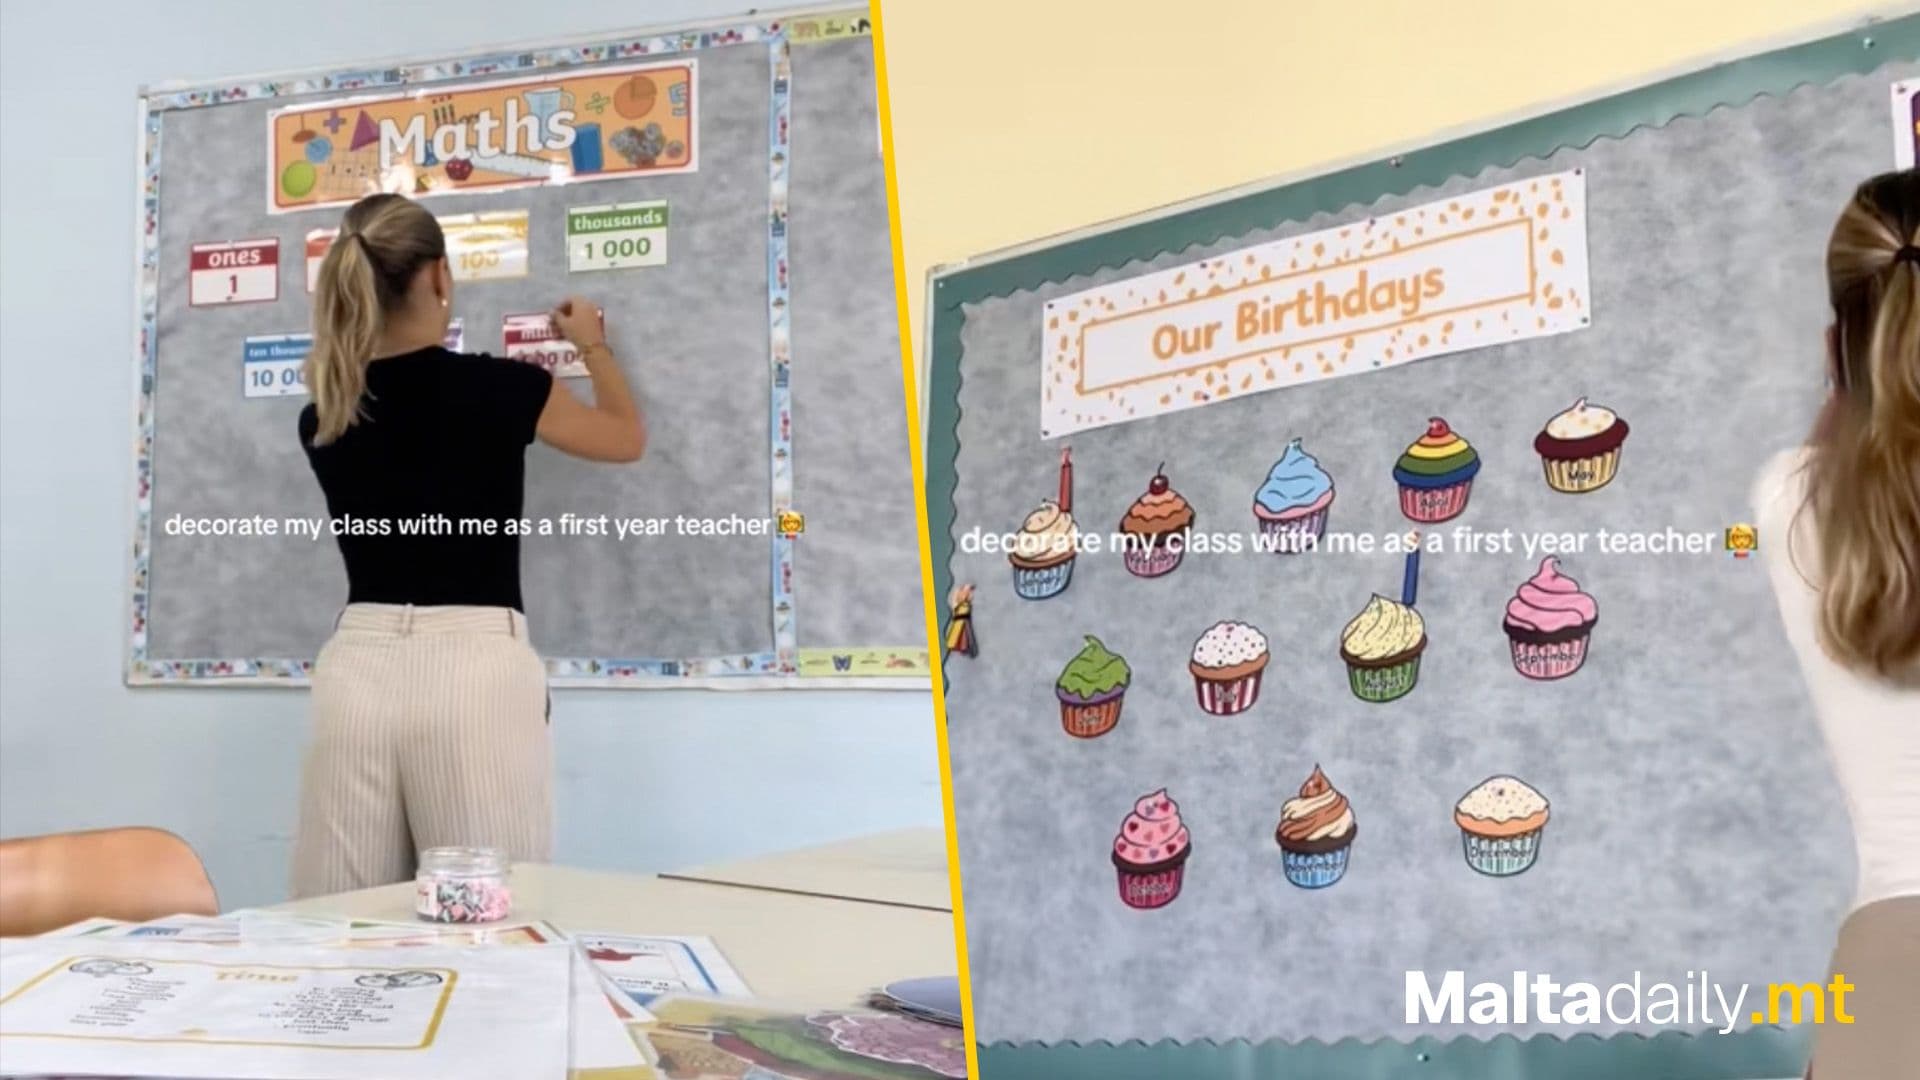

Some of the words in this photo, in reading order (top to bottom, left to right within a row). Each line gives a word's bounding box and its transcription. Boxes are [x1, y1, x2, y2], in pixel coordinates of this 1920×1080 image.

[378, 99, 576, 170] Maths
[573, 210, 663, 231] thousands
[208, 249, 262, 267] ones
[585, 242, 593, 260] 1
[602, 237, 652, 259] 000
[229, 274, 238, 294] 1
[1152, 319, 1223, 360] Our
[1235, 268, 1445, 342] Birthdays
[253, 369, 274, 387] 10
